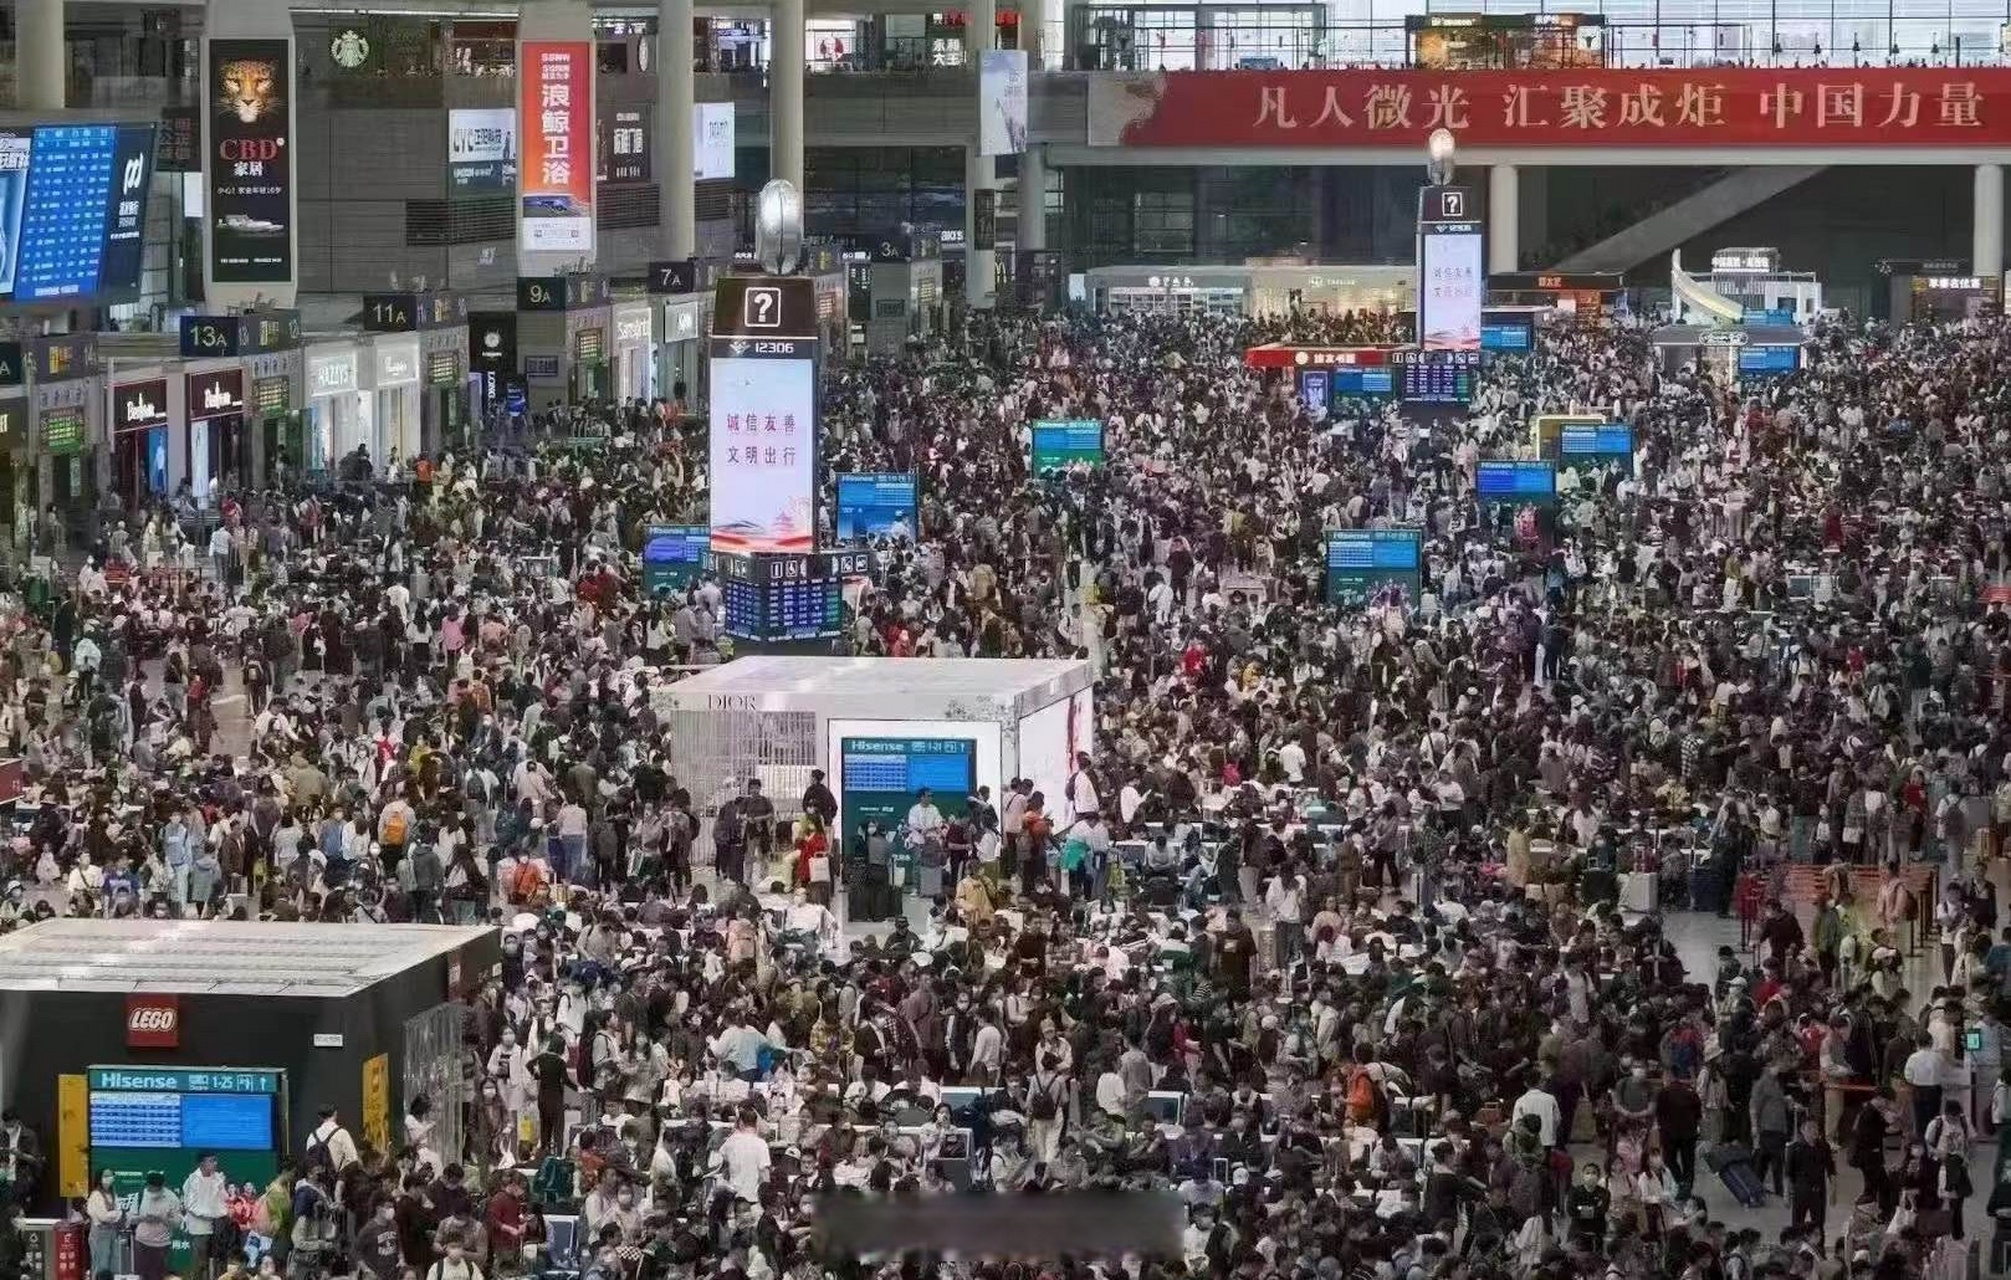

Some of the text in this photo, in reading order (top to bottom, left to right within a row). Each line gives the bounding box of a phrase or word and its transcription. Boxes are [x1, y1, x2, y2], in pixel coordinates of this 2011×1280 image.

[933, 38, 960, 51] 永和
[933, 53, 960, 66] 大王
[1253, 82, 1985, 129] 凡人微光 汇聚成炬 中国力量
[541, 84, 571, 186] 浪鲸卫浴
[220, 139, 277, 160] CBD
[234, 161, 264, 176] 家居
[881, 242, 898, 257] 3A
[660, 269, 682, 285] 7A
[530, 285, 551, 303] 9A
[373, 303, 406, 323] 11A
[189, 327, 228, 349] 13A
[755, 342, 794, 354] 12306
[727, 412, 797, 433] 诚信友善
[726, 446, 797, 467] 文明出行
[709, 694, 756, 710] DIOR
[851, 741, 904, 750] Hisense
[130, 1008, 175, 1030] LEGO
[101, 1073, 178, 1089] Hisense
